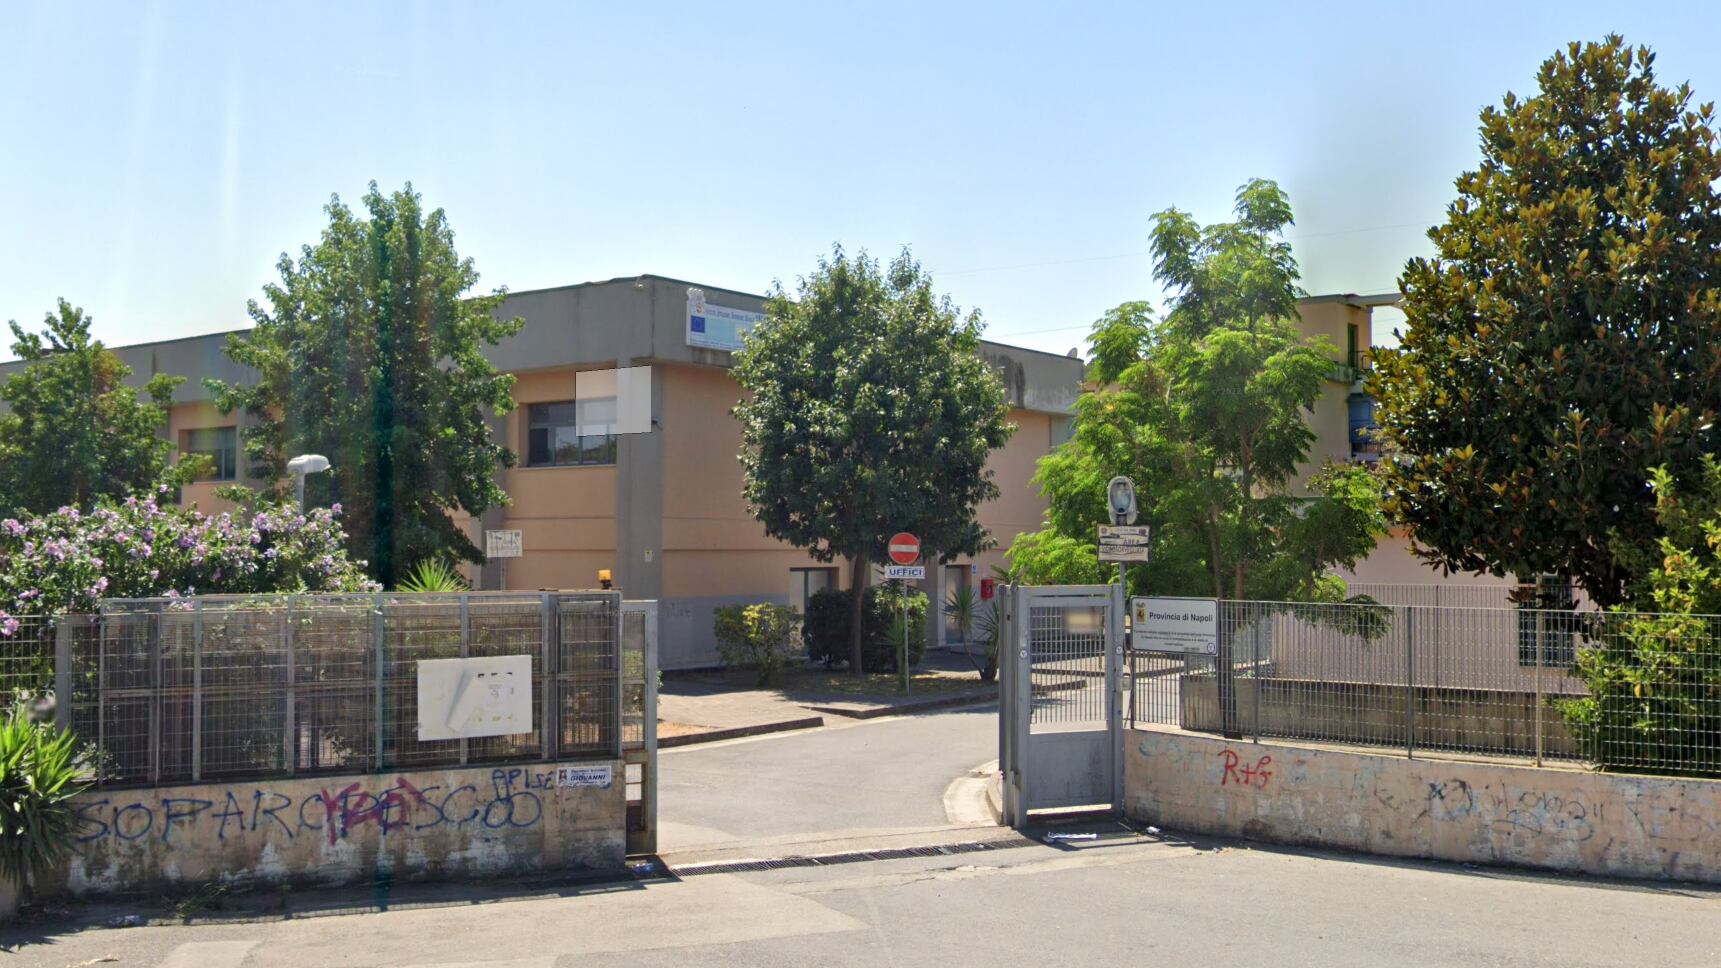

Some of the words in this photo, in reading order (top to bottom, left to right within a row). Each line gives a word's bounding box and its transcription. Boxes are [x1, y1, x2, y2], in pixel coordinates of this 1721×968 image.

[889, 568, 922, 576] UFFICI
[1149, 611, 1180, 621] Provincia
[1182, 612, 1189, 621] di
[1190, 613, 1213, 624] Napoli
[570, 774, 606, 782] GIOVANNI
